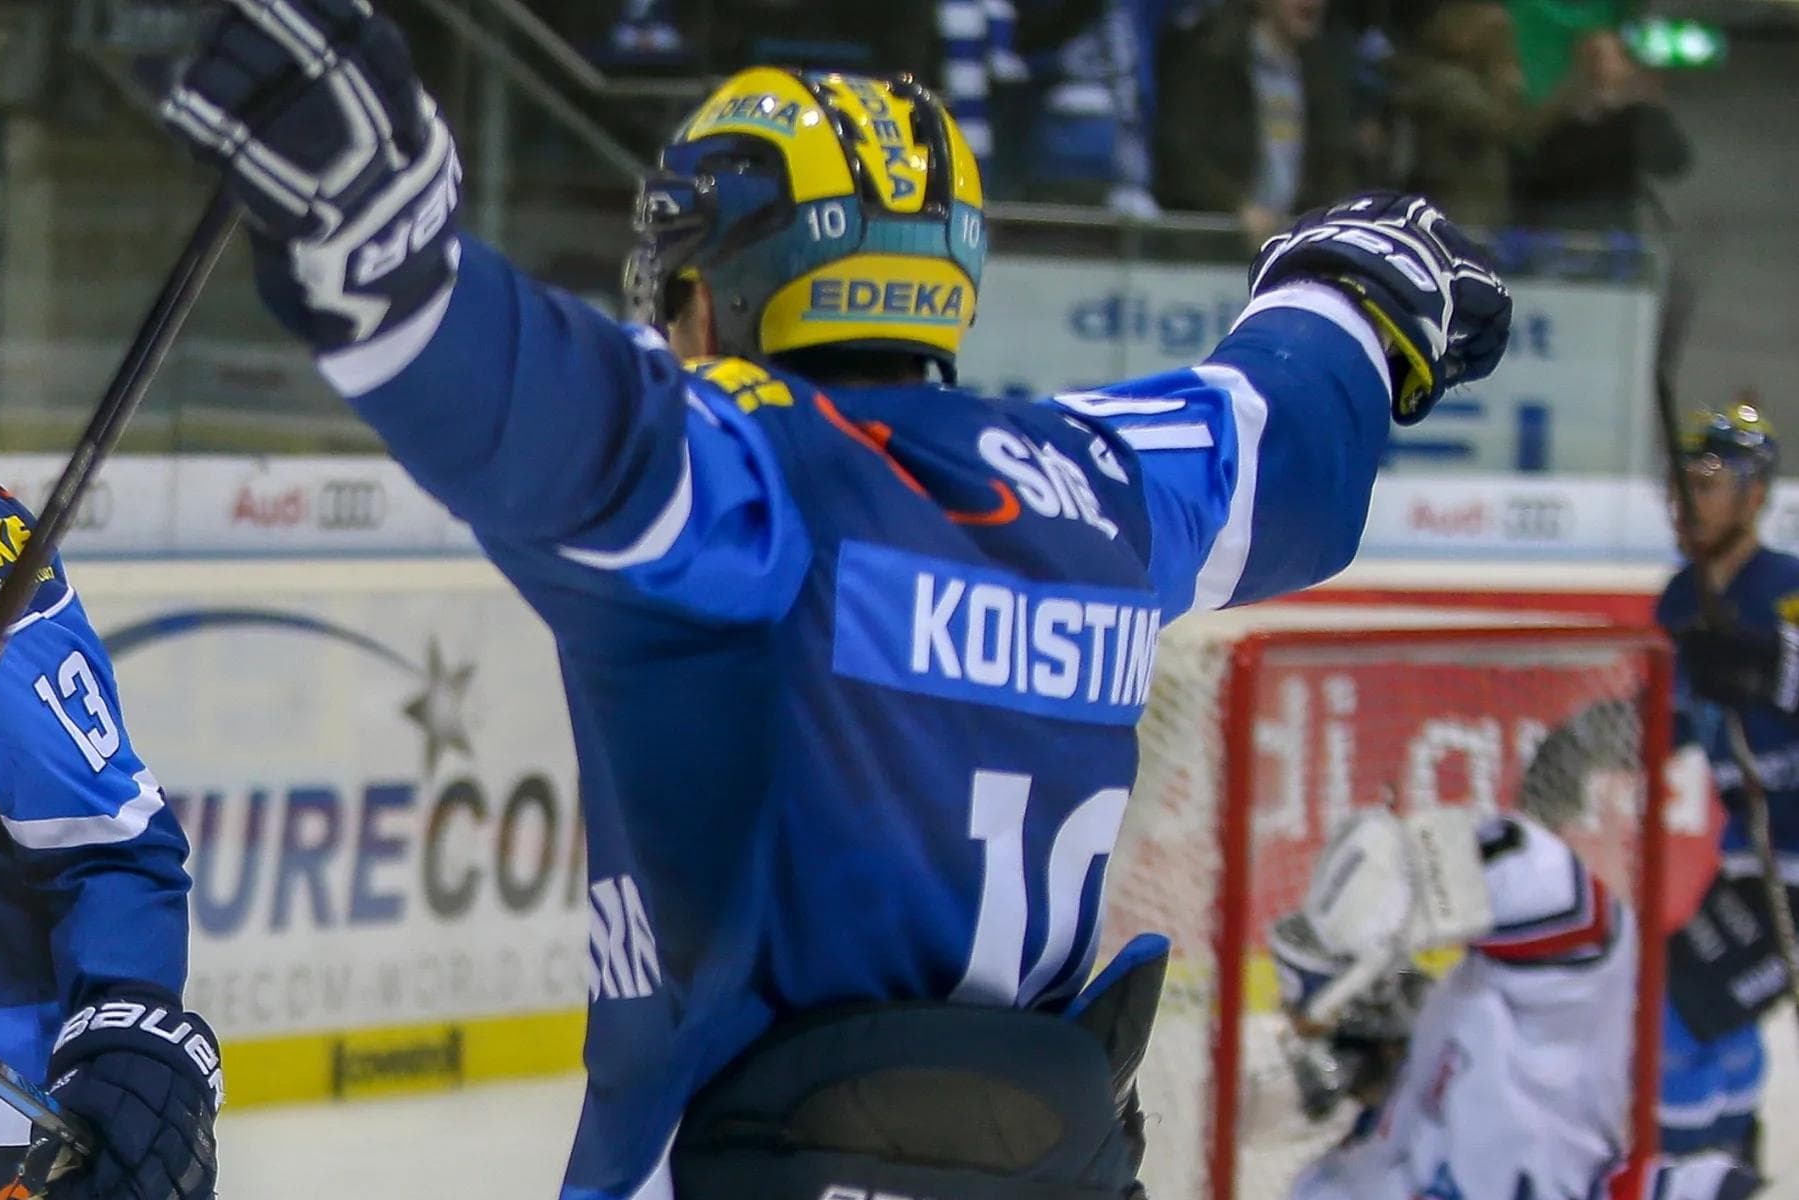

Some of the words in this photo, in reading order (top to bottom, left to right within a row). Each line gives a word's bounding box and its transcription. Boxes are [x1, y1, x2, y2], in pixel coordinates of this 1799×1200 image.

[808, 203, 847, 242] 10
[963, 213, 982, 249] 10
[811, 279, 964, 316] EDEKA
[232, 485, 307, 528] Audi
[38, 651, 120, 772] 13
